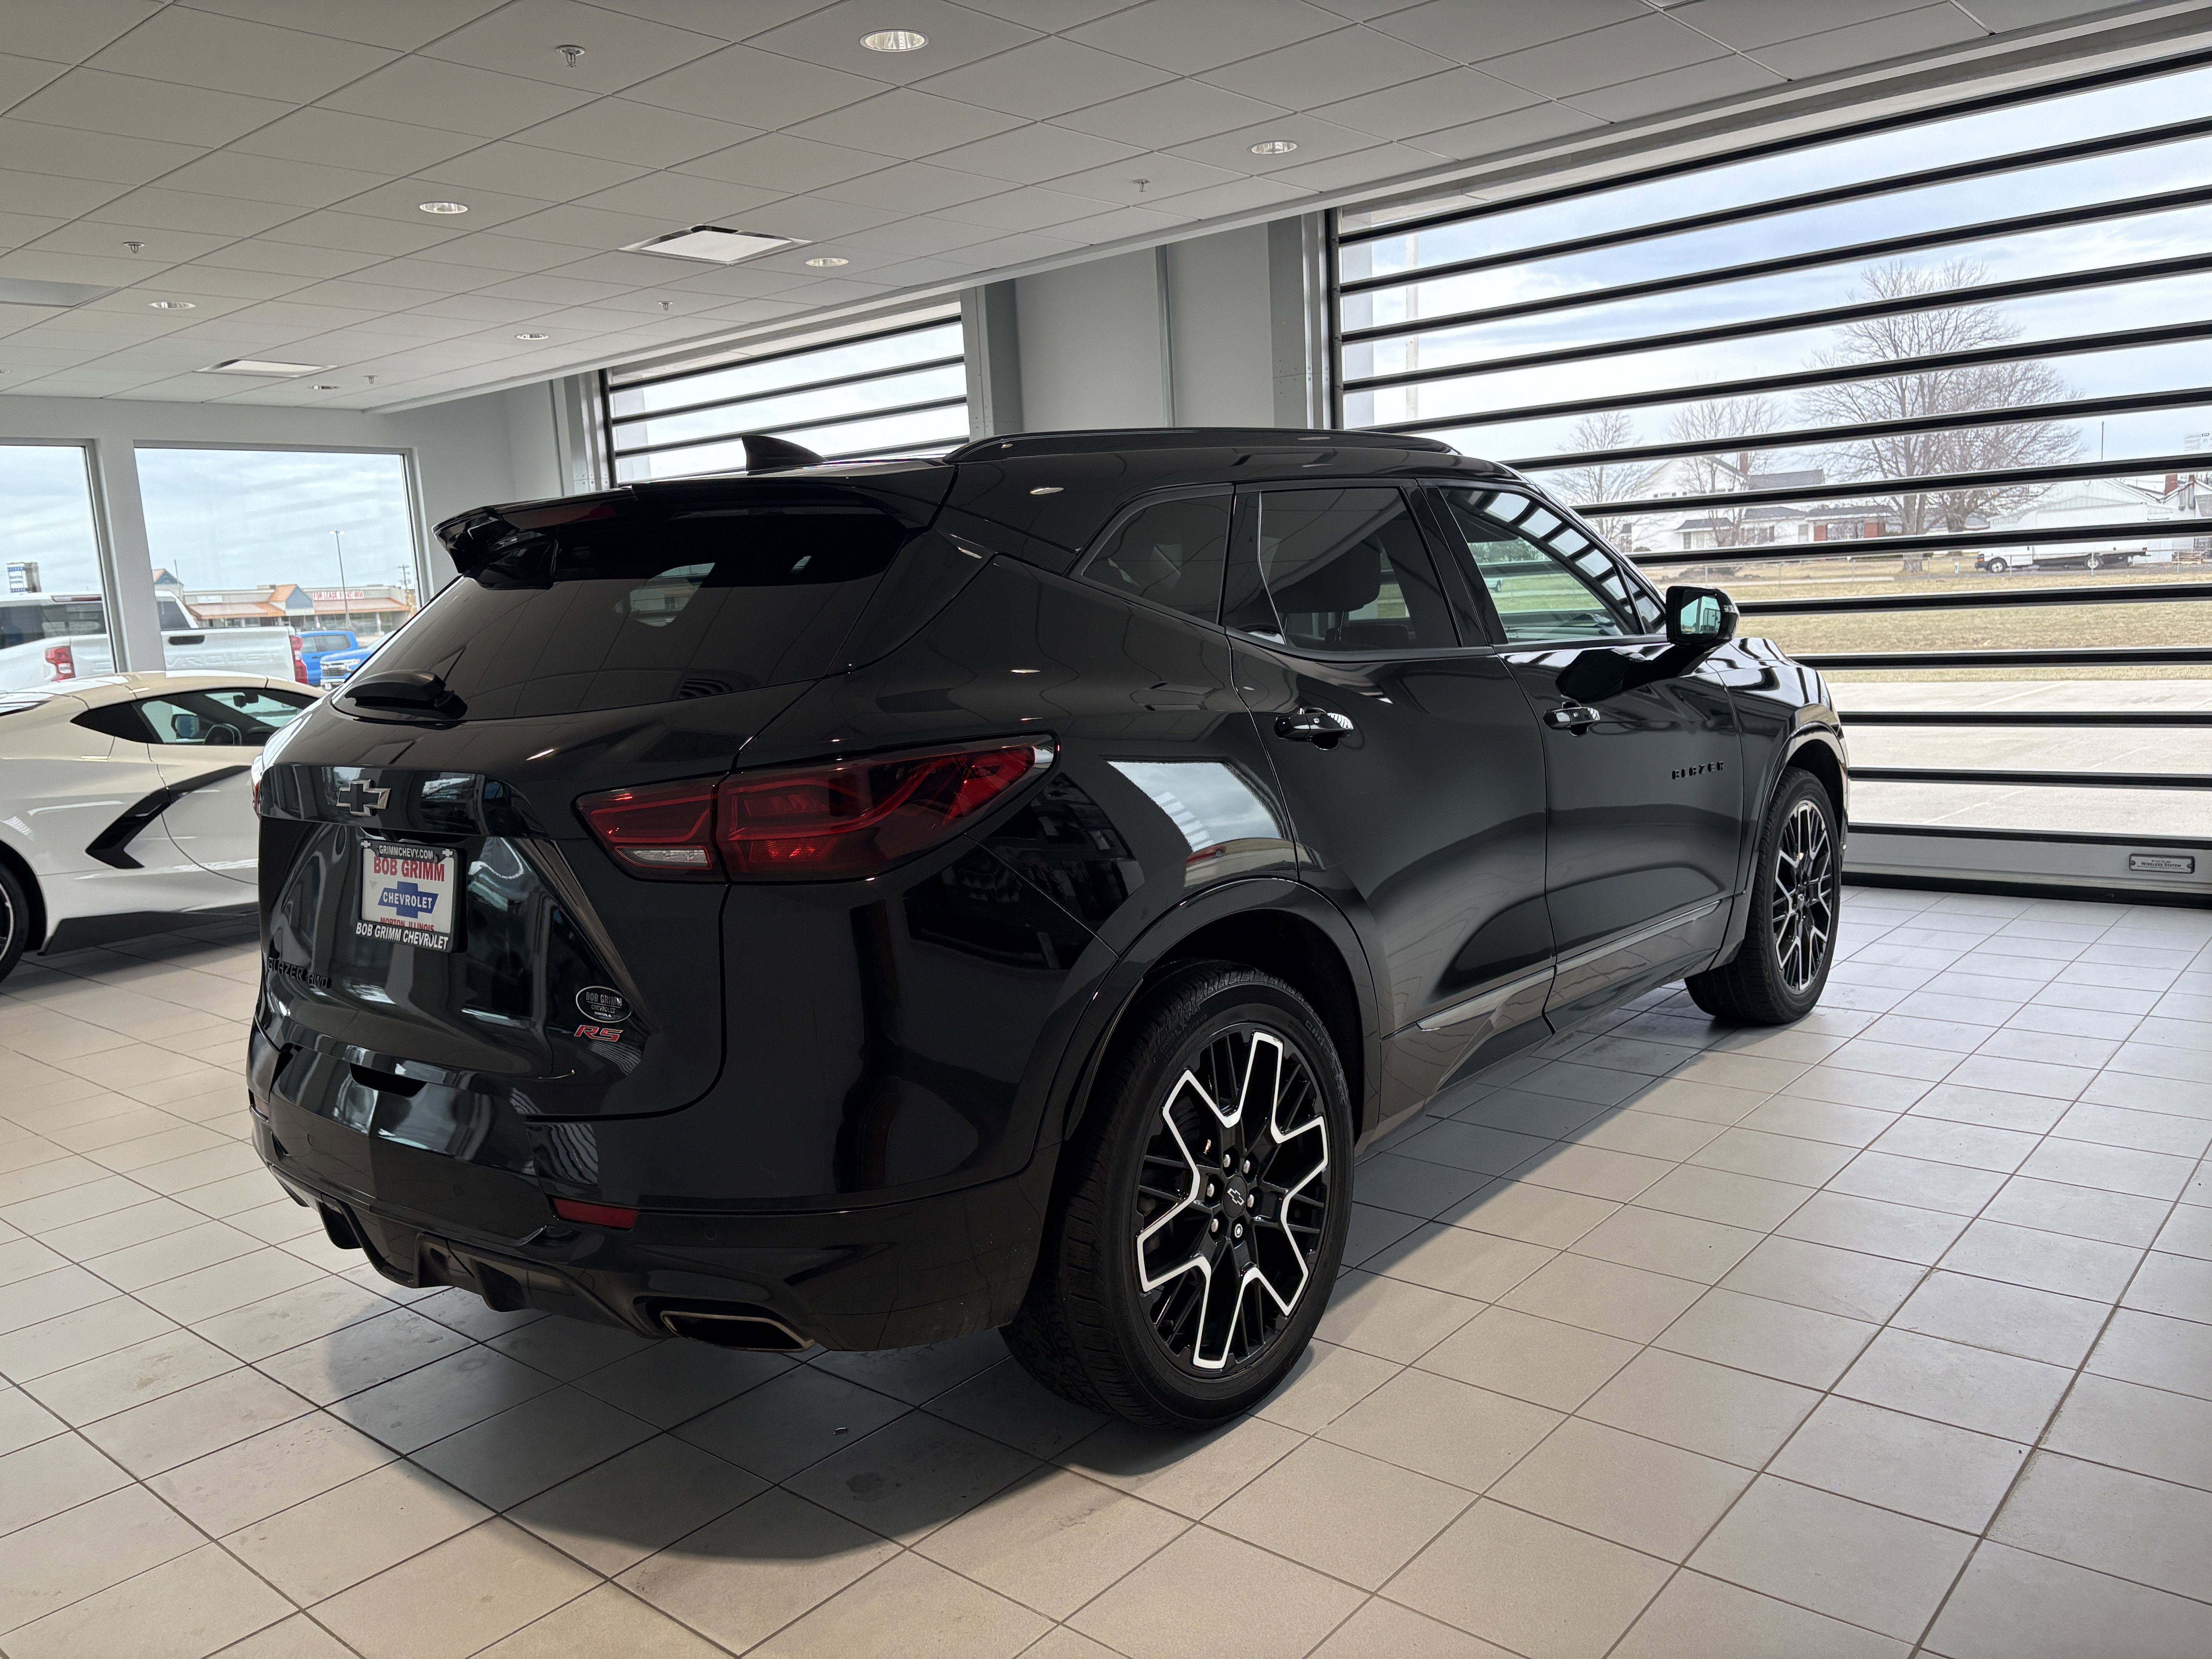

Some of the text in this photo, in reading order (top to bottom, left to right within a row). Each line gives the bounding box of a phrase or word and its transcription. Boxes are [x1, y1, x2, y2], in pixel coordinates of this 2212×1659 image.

[379, 845, 434, 860] GRIMMCHEVY.COM
[374, 856, 445, 882] BOB GRIMM
[383, 891, 433, 909] CHEVROLET
[380, 917, 434, 932] MORTON ILLINOIS
[356, 922, 449, 950] BOB GRIMM CHEVROLET
[268, 957, 332, 988] BLAZER AWD
[586, 991, 622, 1006] BOB GRIMM
[591, 1004, 616, 1014] CHEVROLET
[1185, 1006, 1200, 1021] SPORT
[574, 1024, 625, 1042] RS
